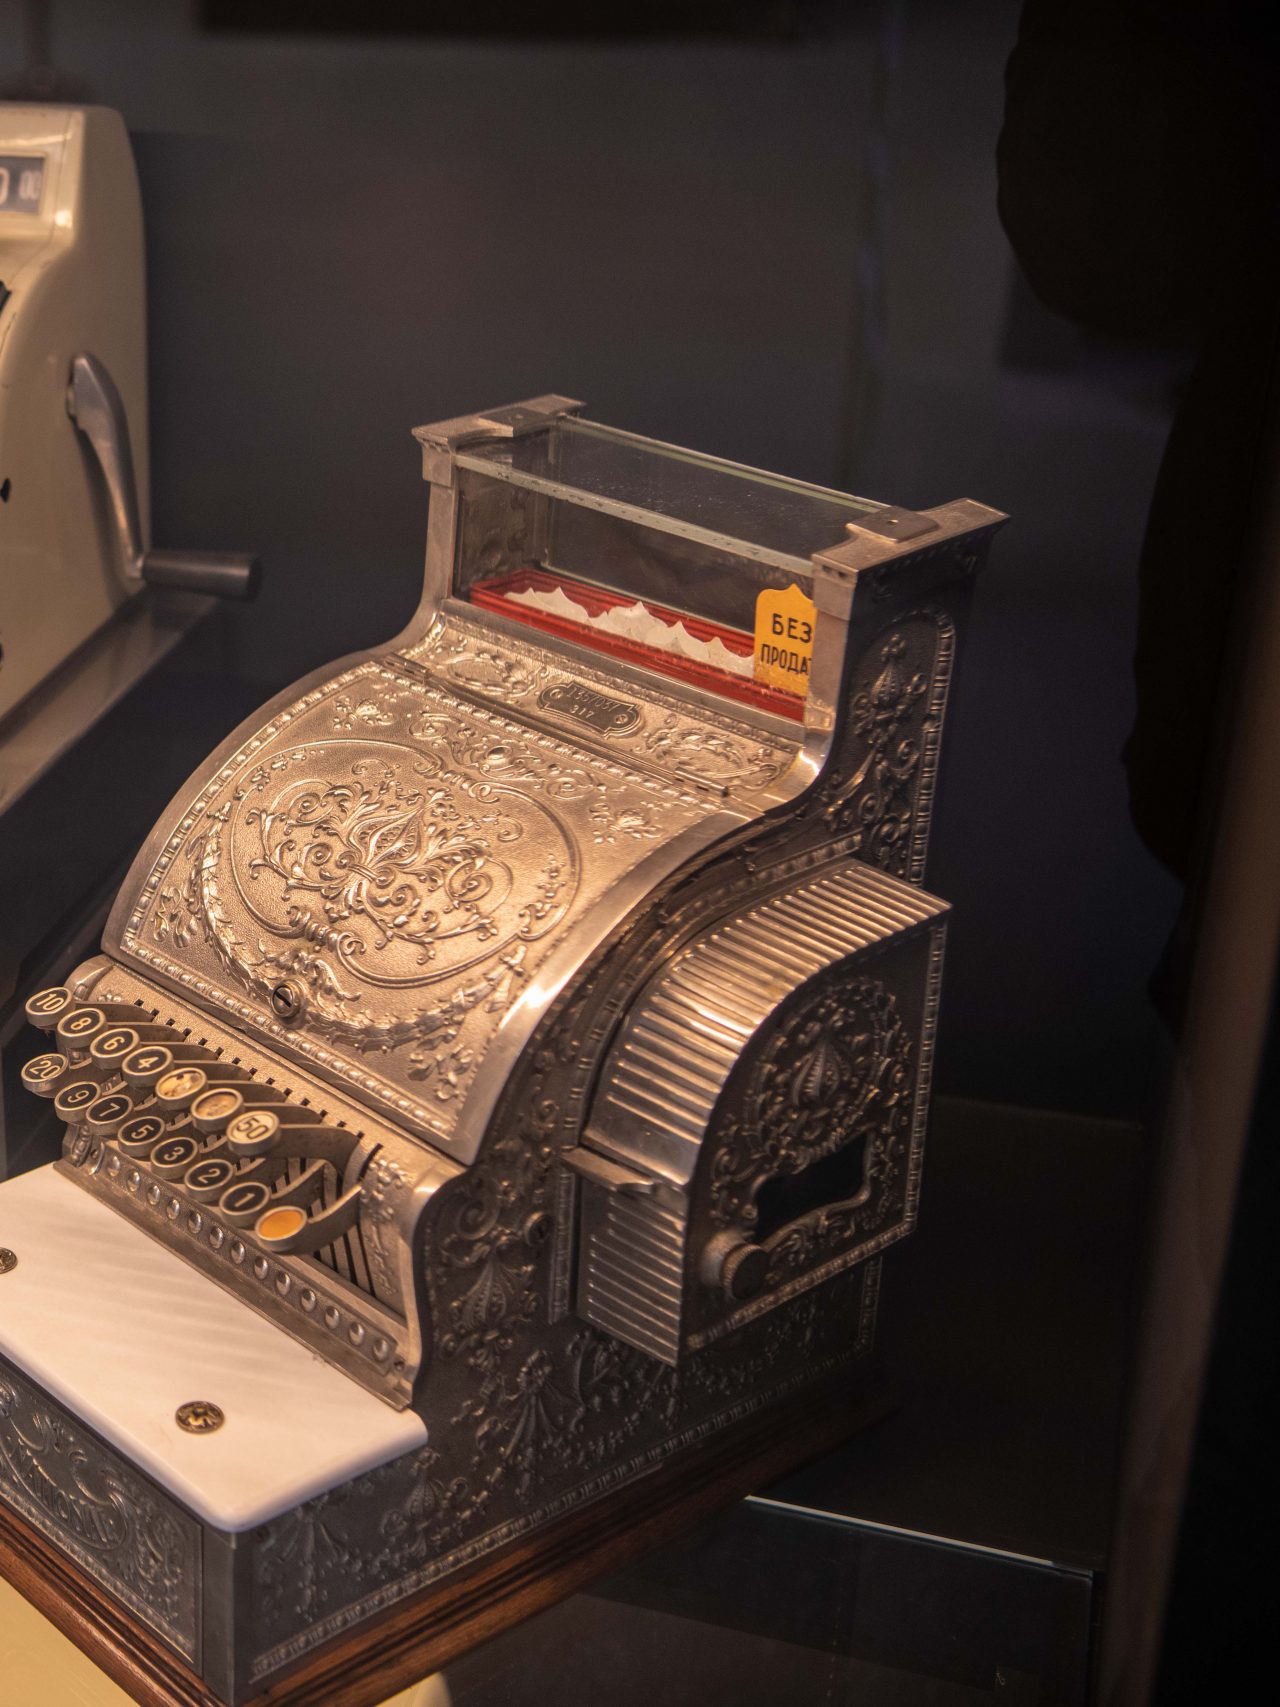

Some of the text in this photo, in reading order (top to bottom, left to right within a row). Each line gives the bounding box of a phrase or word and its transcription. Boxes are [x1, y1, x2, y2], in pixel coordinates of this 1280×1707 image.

[772, 613, 812, 643] БЕЗ
[761, 643, 811, 675] ПРОДА
[36, 993, 64, 1011] 10
[70, 1017, 92, 1031] 8
[103, 1036, 125, 1051] 6
[29, 1059, 61, 1080] 20
[138, 1056, 159, 1069] 4
[67, 1090, 90, 1103] 9
[99, 1102, 121, 1117] 7
[131, 1124, 155, 1139] 5
[236, 1117, 269, 1140] 50
[163, 1146, 185, 1161] 3
[197, 1168, 221, 1184] 2
[233, 1192, 256, 1208] 1
